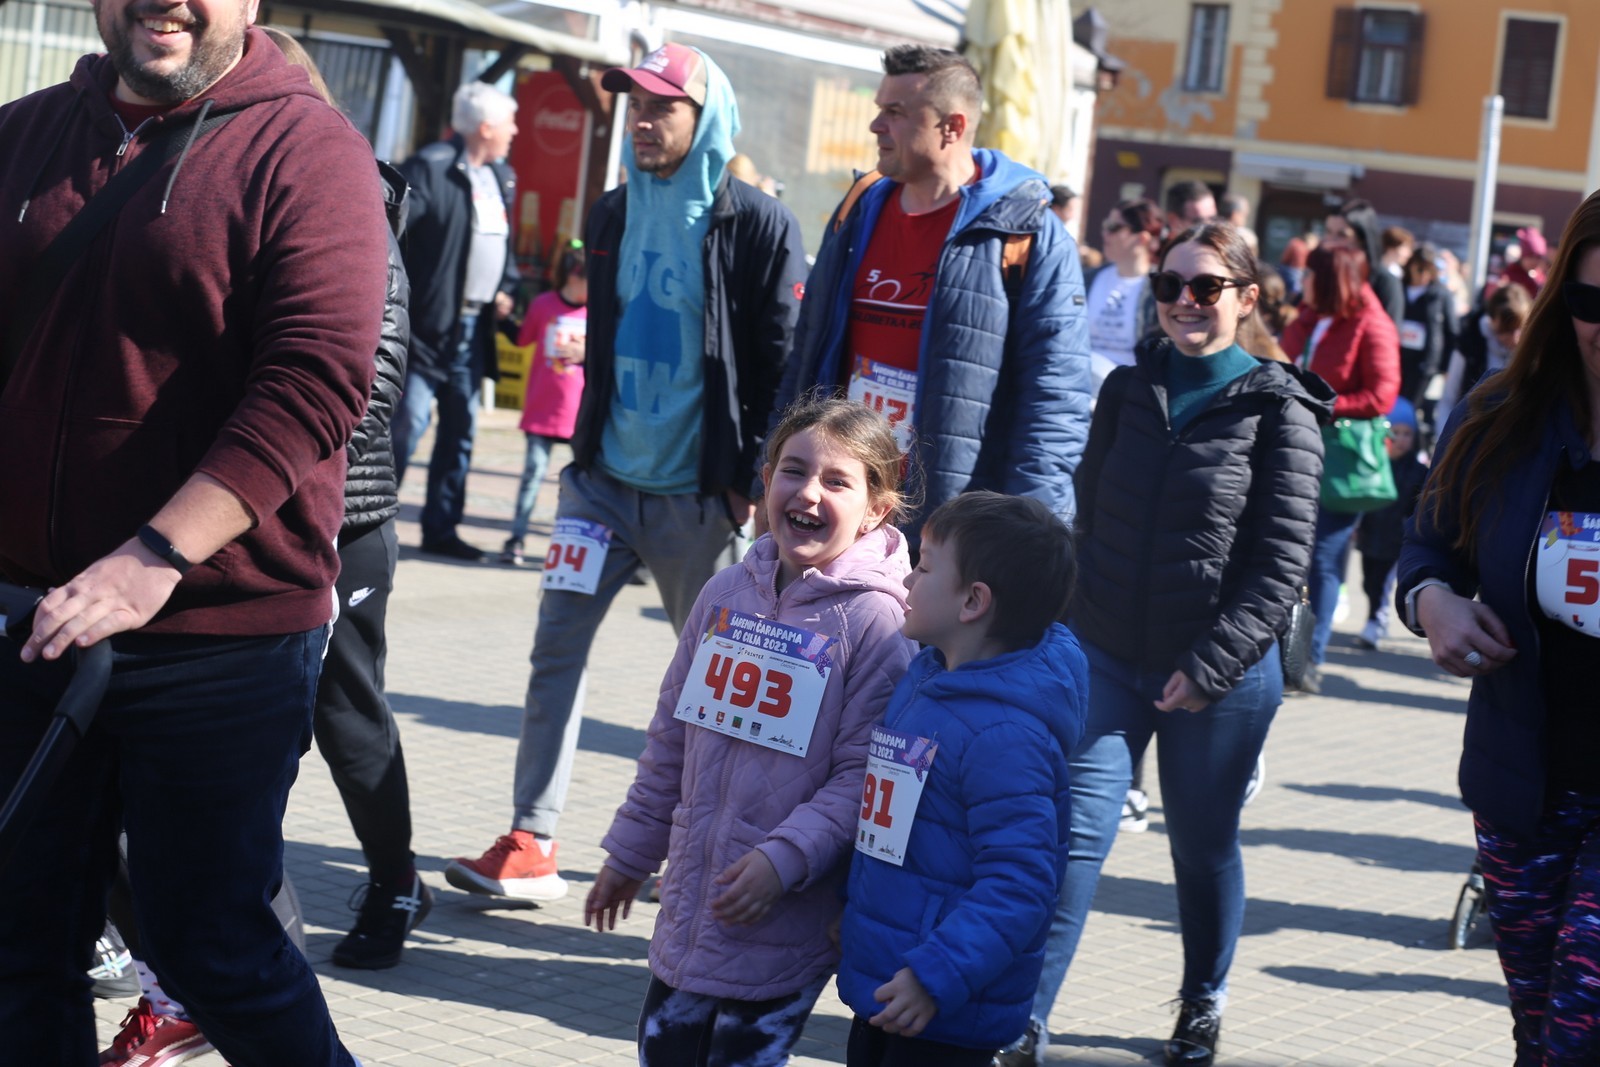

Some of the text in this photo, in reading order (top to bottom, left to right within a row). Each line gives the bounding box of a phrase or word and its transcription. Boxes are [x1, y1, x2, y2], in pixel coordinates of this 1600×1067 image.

[866, 269, 882, 283] 5
[732, 629, 742, 641] DO
[742, 631, 762, 647] CILJA
[756, 620, 803, 645] ČARAPAMA
[704, 653, 793, 718] 493
[861, 772, 895, 829] 91
